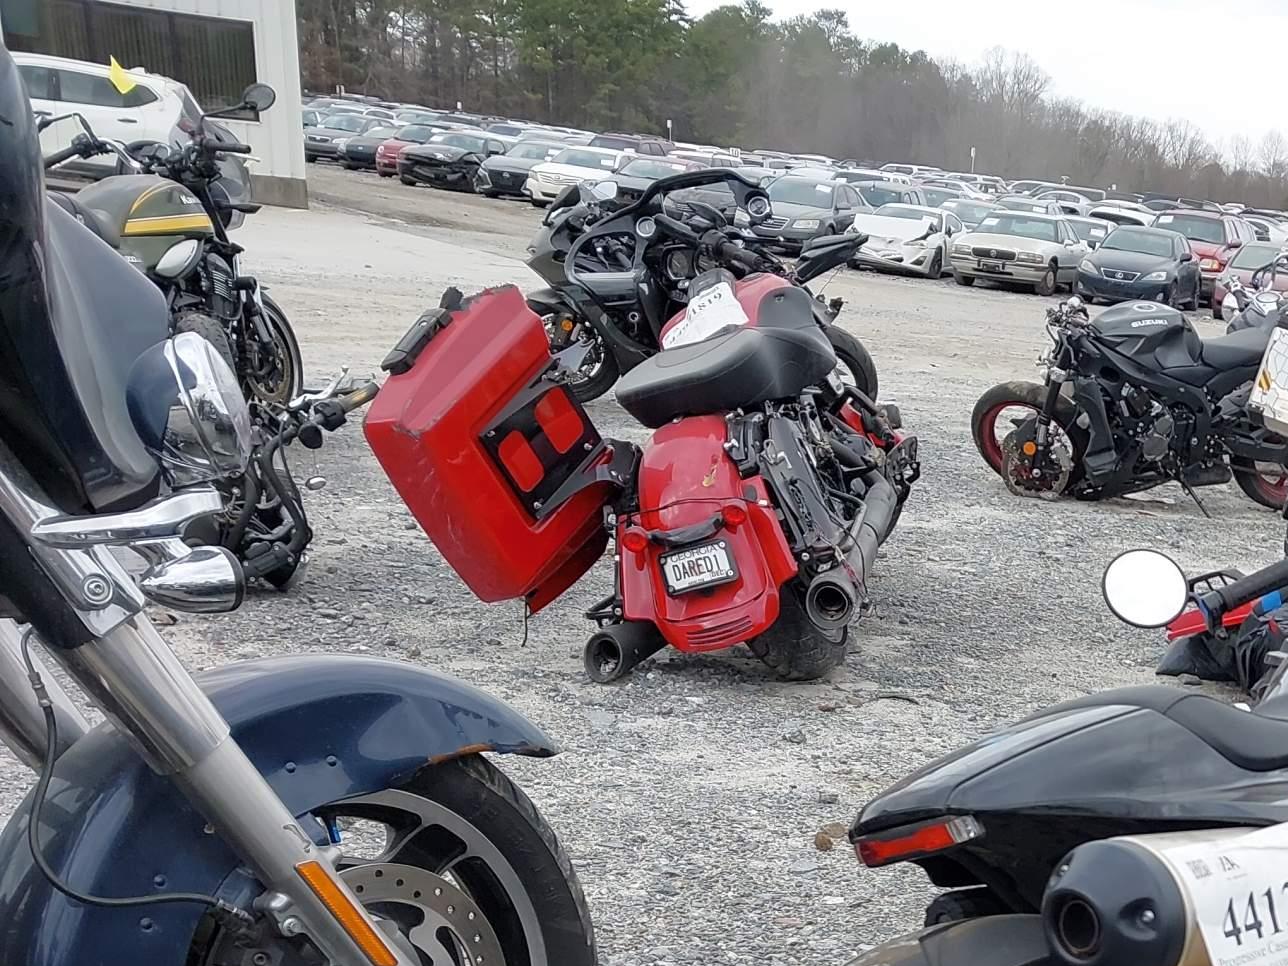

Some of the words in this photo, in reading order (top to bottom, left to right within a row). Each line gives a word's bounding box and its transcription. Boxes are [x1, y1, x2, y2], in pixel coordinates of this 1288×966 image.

[1131, 319, 1168, 328] SUZUKI
[670, 544, 718, 562] GEORGIA
[672, 555, 721, 581] DARED1
